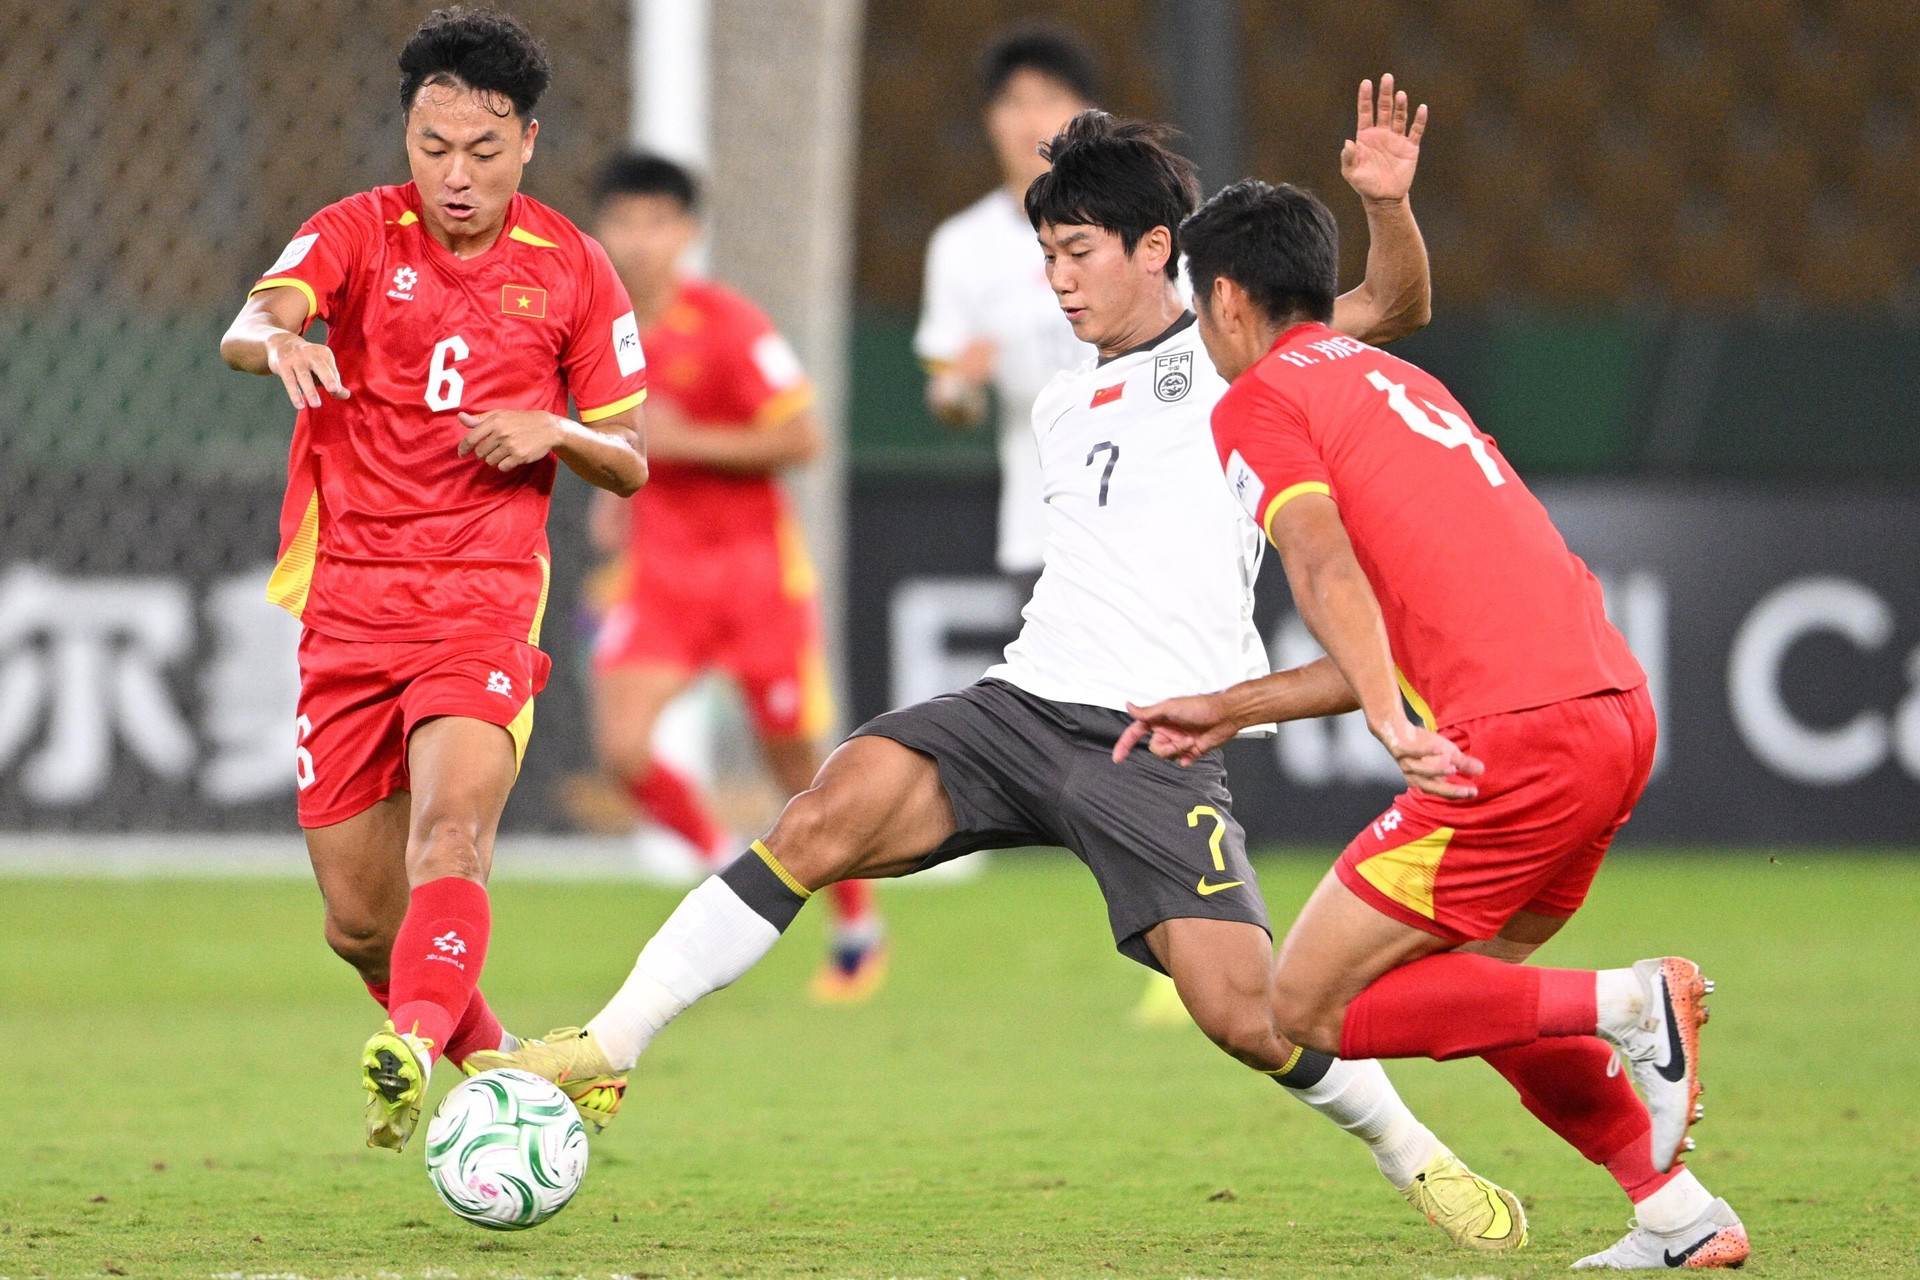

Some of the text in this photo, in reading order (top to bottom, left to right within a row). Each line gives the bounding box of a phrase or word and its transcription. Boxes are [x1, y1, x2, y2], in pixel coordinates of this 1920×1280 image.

[424, 335, 470, 412] 6
[1159, 354, 1189, 367] CFA
[1364, 369, 1507, 488] 4
[1085, 441, 1120, 507] 7
[1728, 576, 1920, 787] C
[296, 712, 316, 791] 6
[1187, 805, 1226, 871] 7
